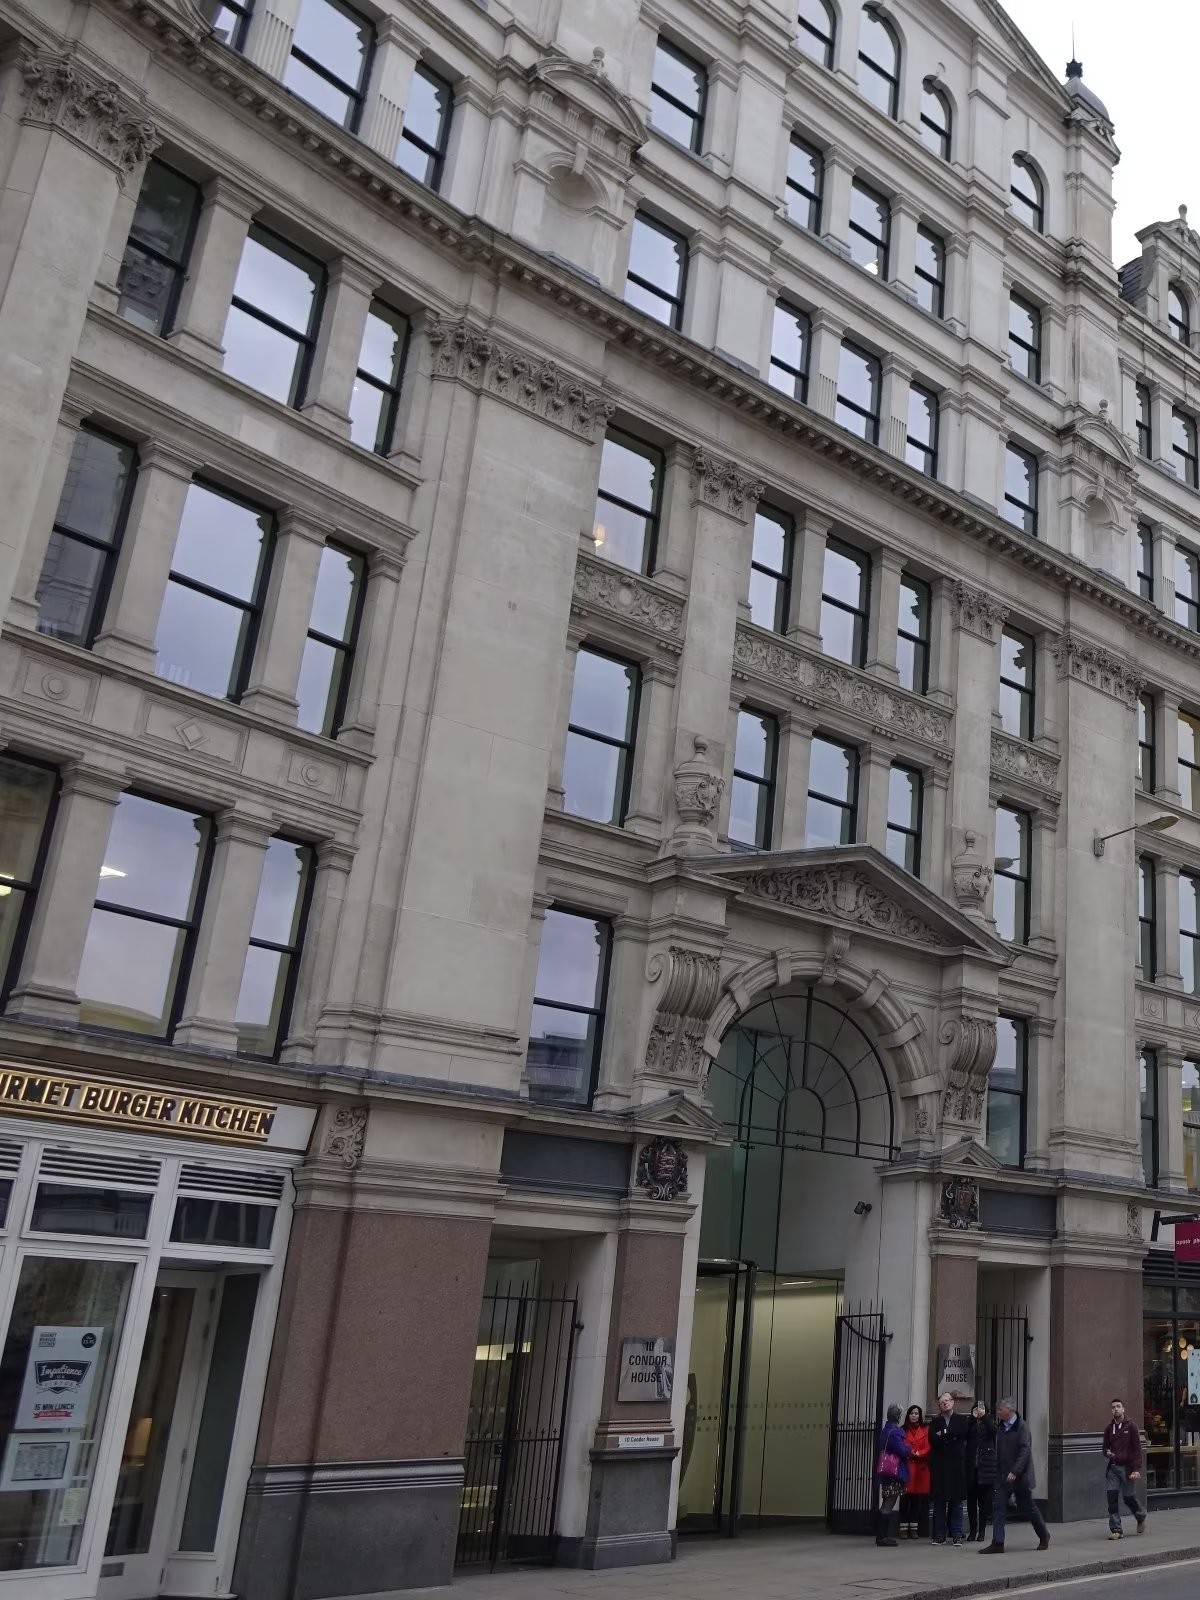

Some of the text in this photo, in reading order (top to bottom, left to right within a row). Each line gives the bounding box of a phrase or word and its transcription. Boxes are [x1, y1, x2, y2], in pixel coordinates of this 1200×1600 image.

[81, 1086, 177, 1121] BURGER
[178, 1101, 276, 1135] KITCHEN
[645, 1341, 655, 1351] 10
[954, 1347, 961, 1357] 10
[628, 1355, 667, 1366] CONDOR
[40, 1364, 82, 1378] Impatience
[630, 1372, 663, 1383] HOUSE
[945, 1373, 968, 1383] HOUSE
[54, 1402, 75, 1410] LUNCH
